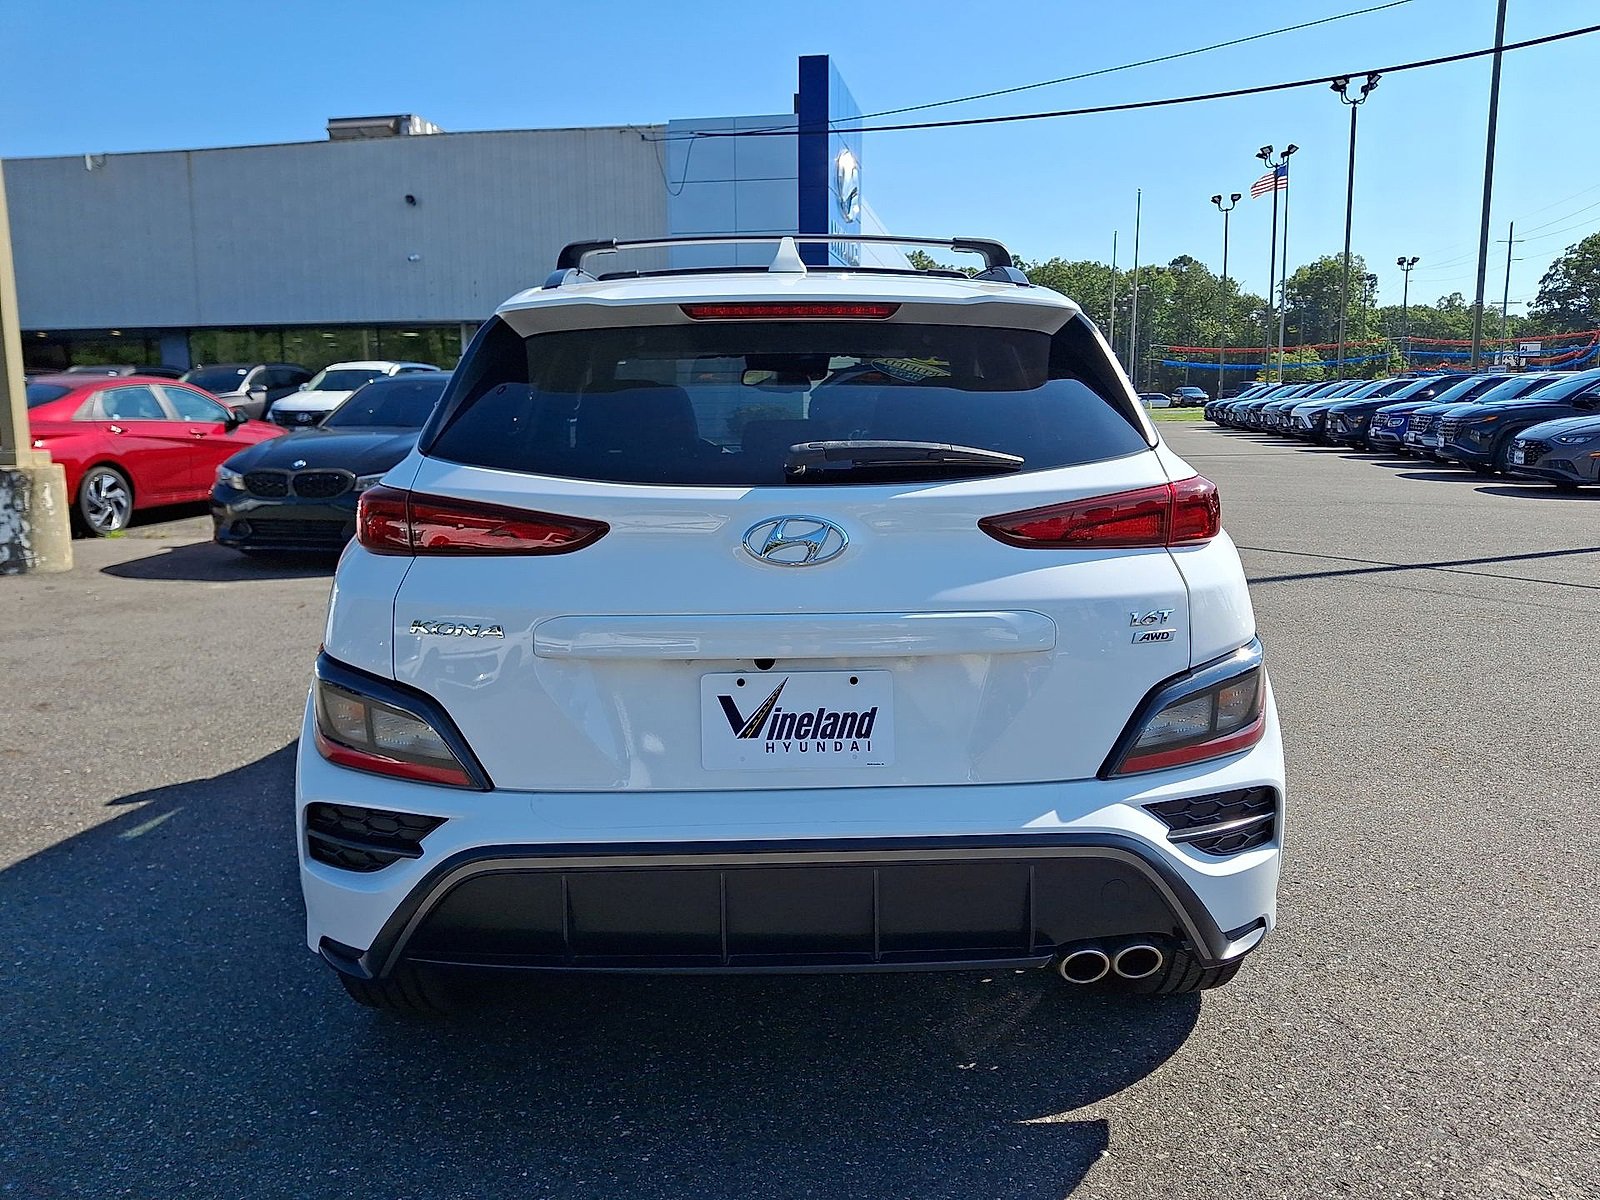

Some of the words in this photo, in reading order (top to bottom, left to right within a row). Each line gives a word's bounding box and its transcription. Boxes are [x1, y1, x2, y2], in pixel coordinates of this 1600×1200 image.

[409, 620, 505, 639] KONA
[1139, 632, 1169, 641] AWD
[716, 676, 878, 740] Vineland
[765, 741, 872, 754] HYUNDAI
